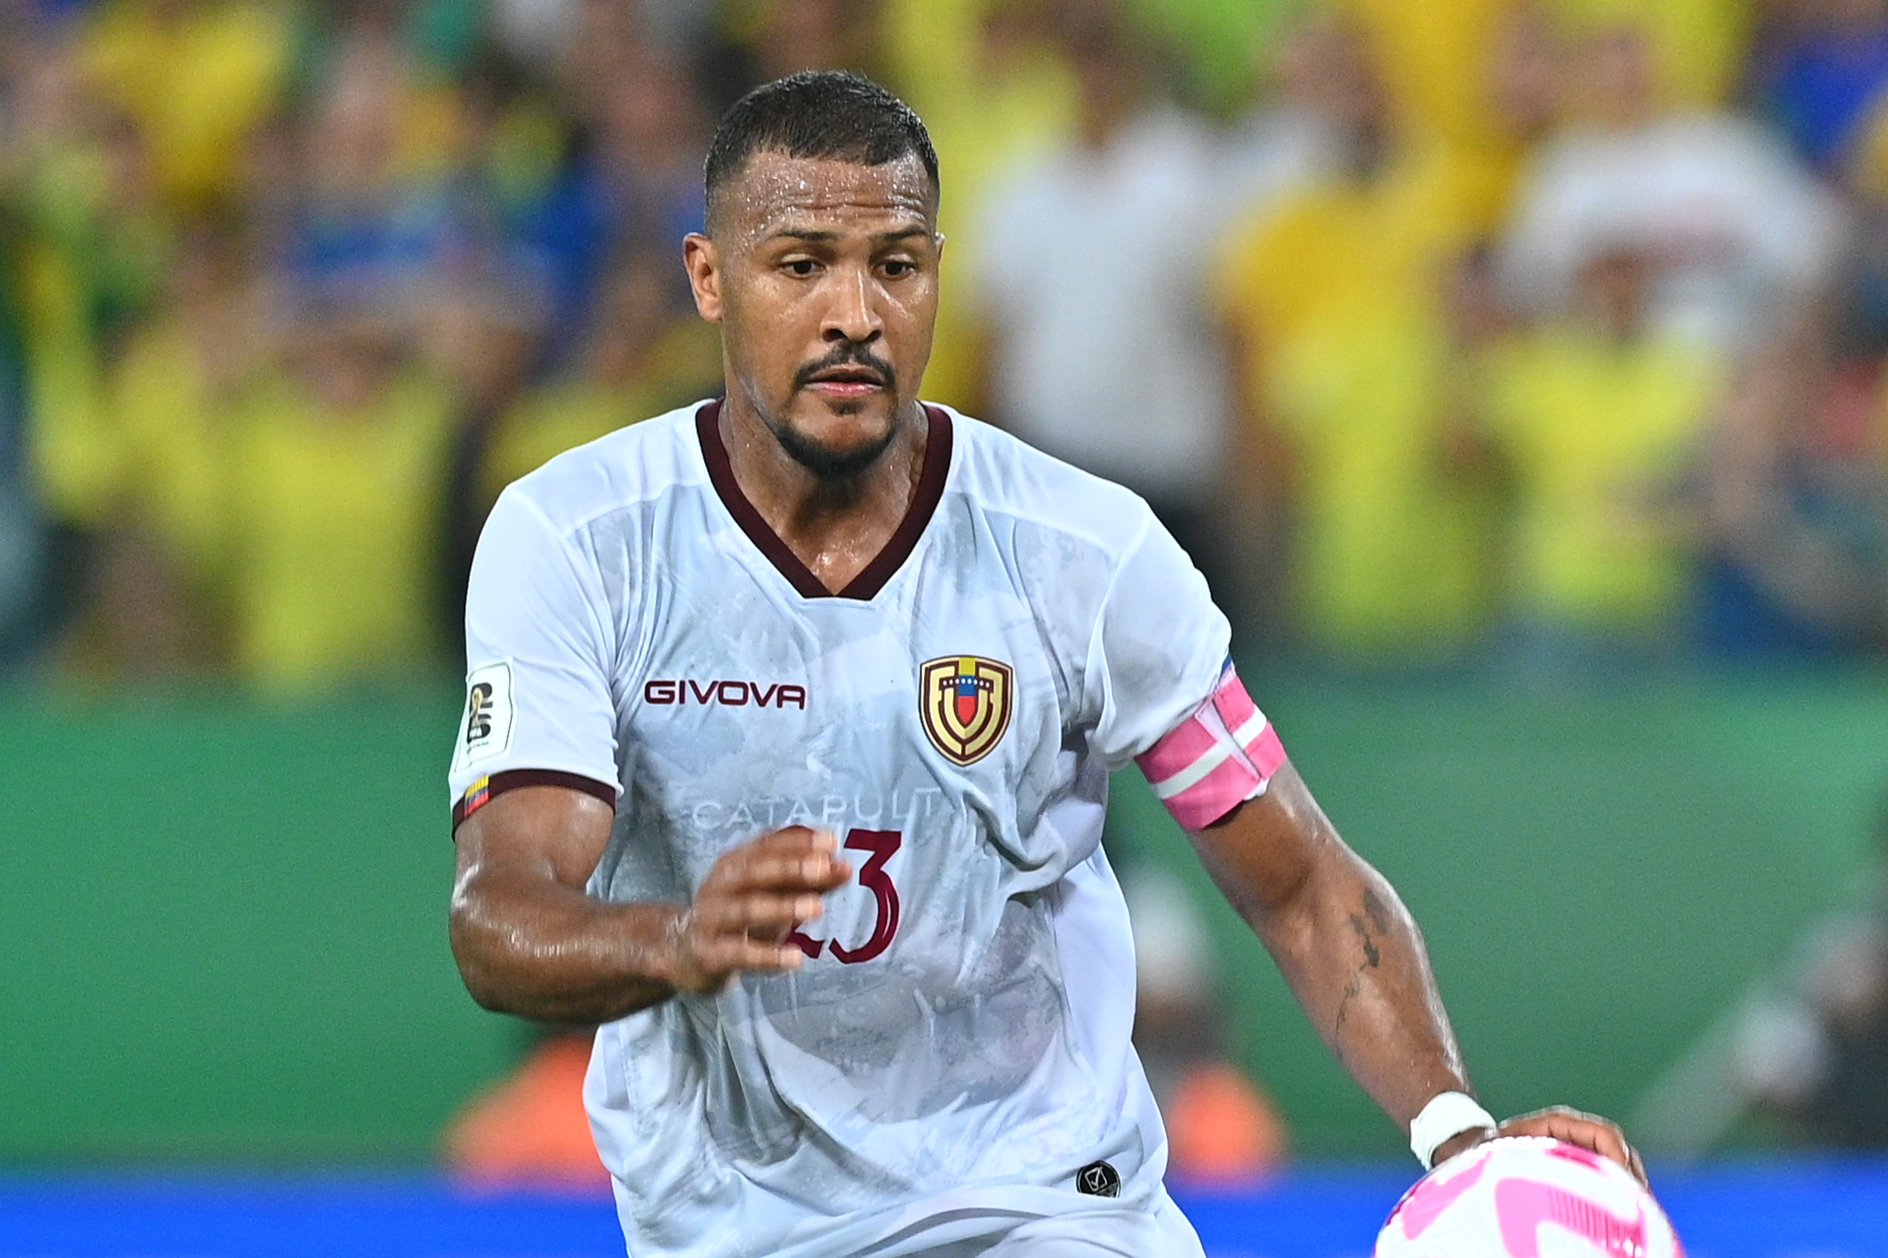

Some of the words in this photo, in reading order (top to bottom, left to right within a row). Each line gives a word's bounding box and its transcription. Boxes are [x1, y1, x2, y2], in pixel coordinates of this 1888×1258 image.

[644, 679, 806, 711] GIVOVA
[691, 786, 944, 831] CATAPULT
[777, 824, 903, 965] 3
